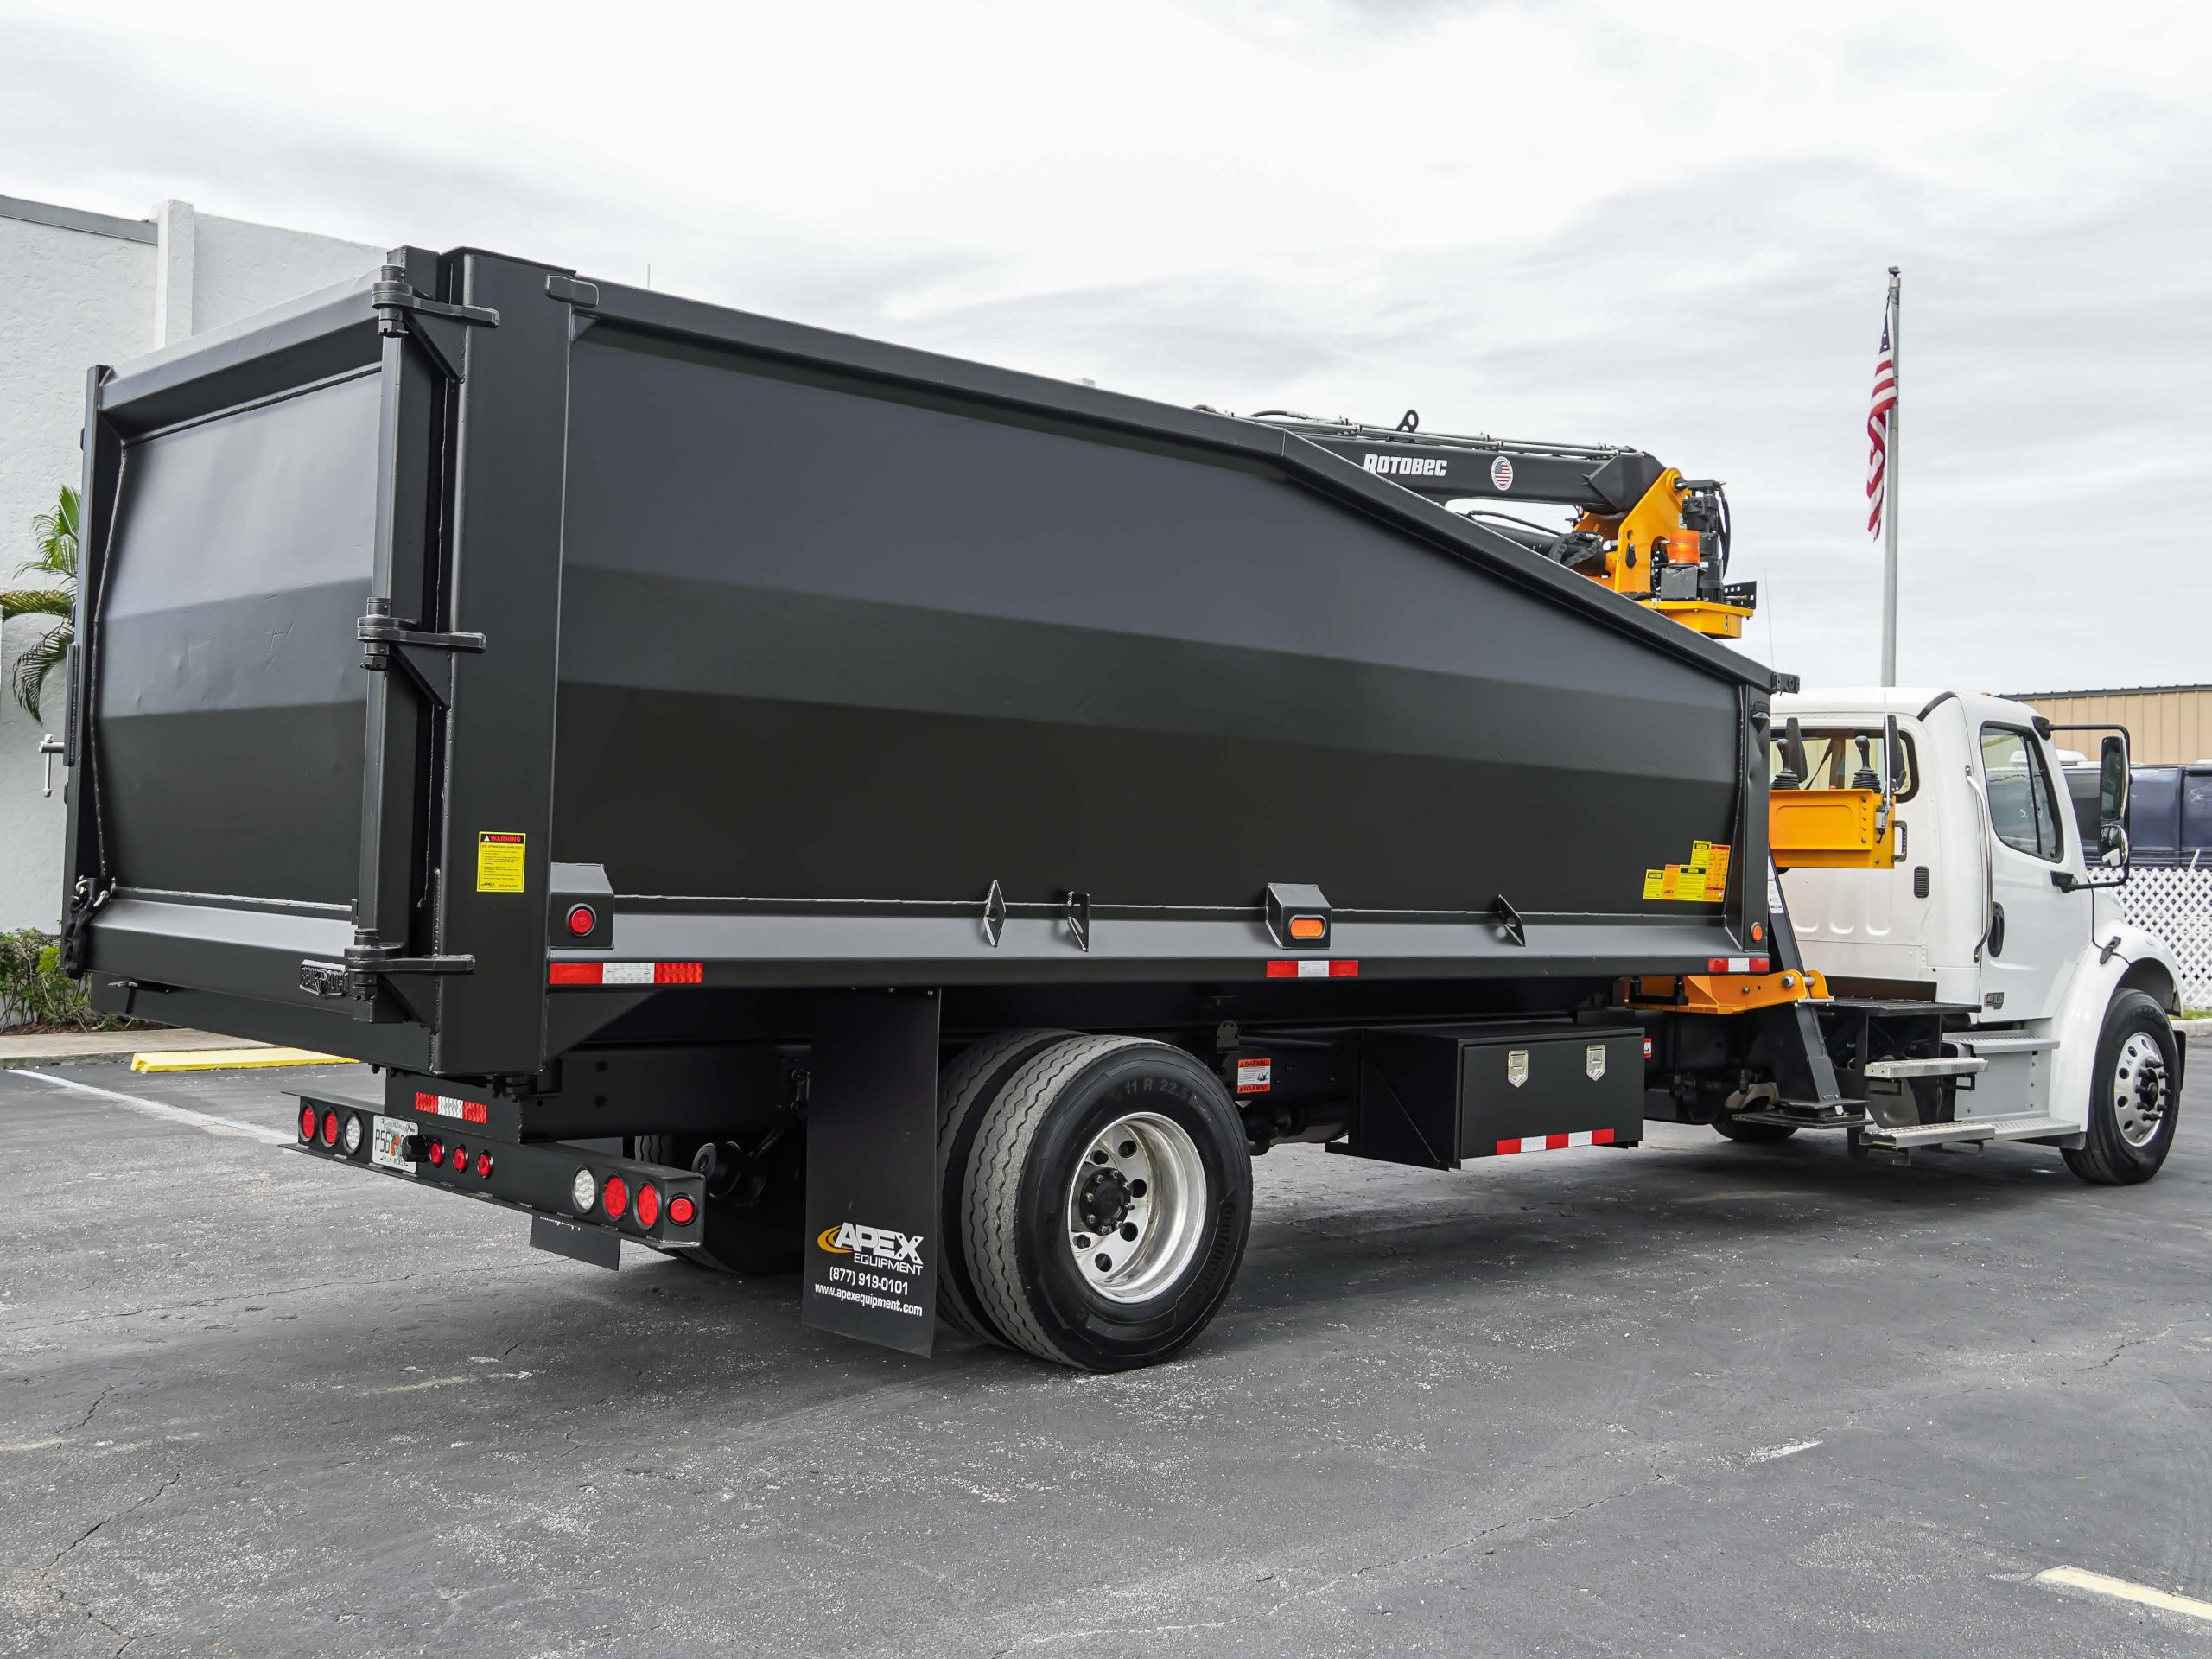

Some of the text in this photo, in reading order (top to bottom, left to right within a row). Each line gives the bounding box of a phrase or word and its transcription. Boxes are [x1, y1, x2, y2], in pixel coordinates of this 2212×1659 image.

[1244, 1058, 1269, 1067] WARNING
[1125, 1077, 1189, 1100] 11 R 22.5
[834, 1222, 924, 1265] APEX
[853, 1253, 924, 1276] EQUIPMENT
[830, 1266, 908, 1296] (877) 919-0101
[814, 1283, 923, 1317] www.apexequipment.com
